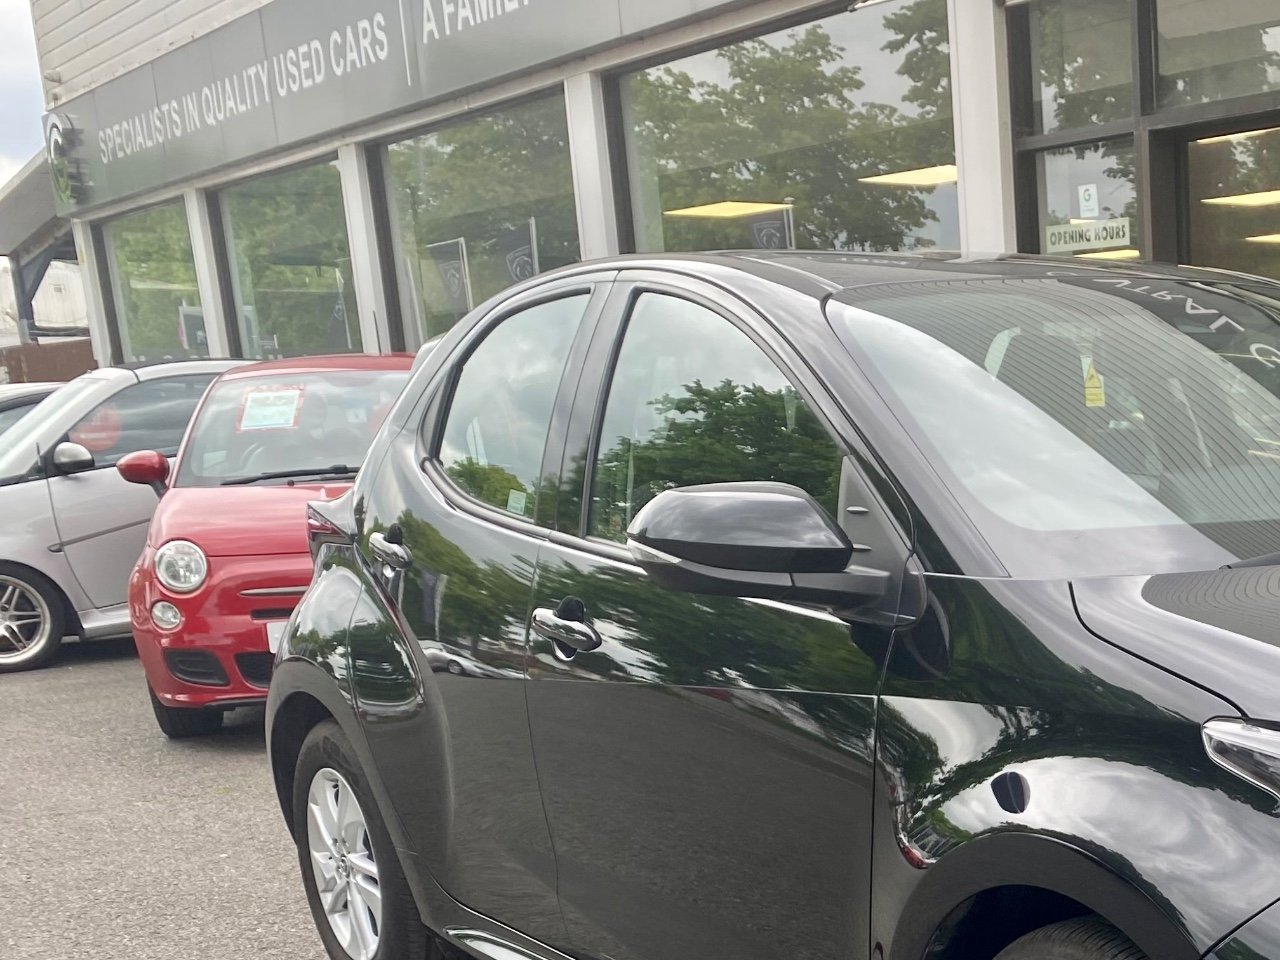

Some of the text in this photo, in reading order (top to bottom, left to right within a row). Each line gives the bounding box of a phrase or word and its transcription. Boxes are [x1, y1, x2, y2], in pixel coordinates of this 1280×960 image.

[422, 0, 529, 44] A FAM
[98, 12, 389, 164] SPECIALISTS IN QUALITY USED CARS
[1050, 225, 1126, 246] OPENING HOURS
